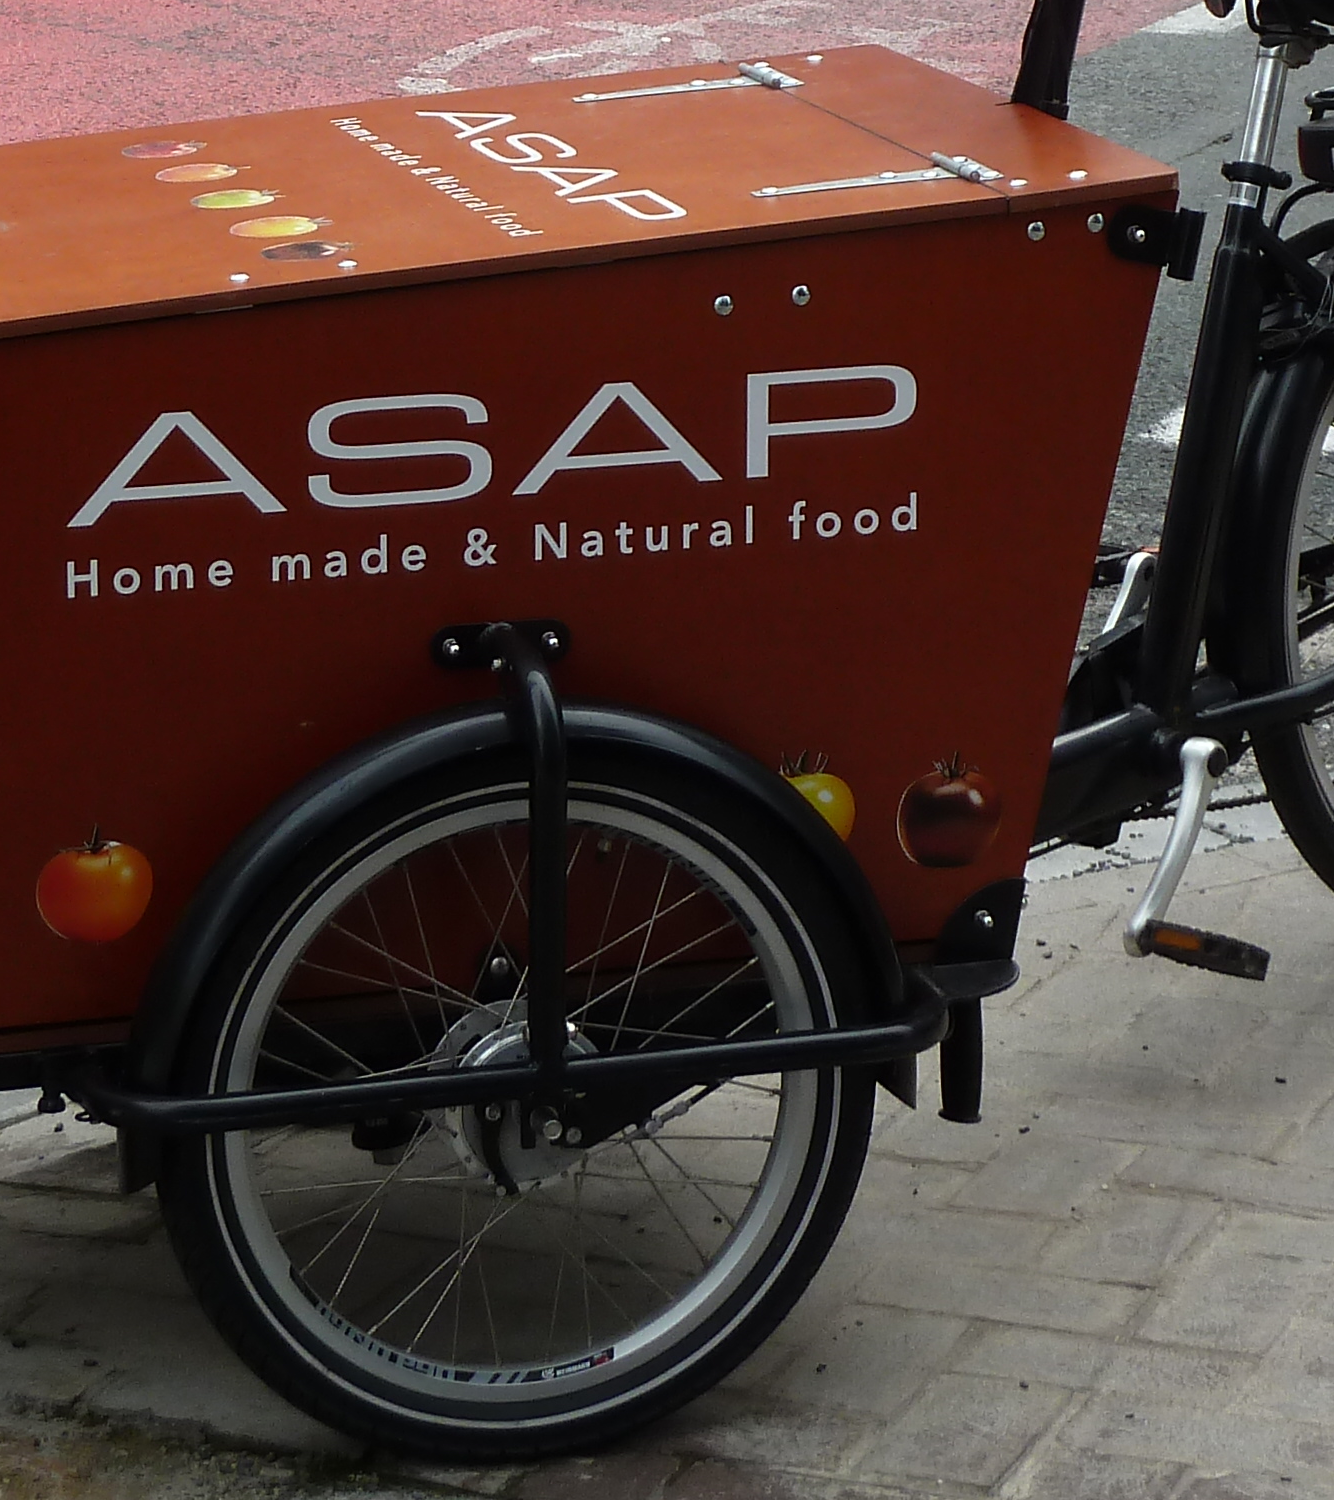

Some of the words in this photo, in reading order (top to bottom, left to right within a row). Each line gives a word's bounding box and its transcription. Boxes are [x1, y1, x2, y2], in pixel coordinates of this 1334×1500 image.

[329, 116, 378, 143] Home
[369, 142, 422, 167] made
[410, 166, 442, 176] &
[415, 110, 688, 221] ASAP
[425, 175, 504, 212] Natural
[484, 204, 544, 238] food
[66, 364, 918, 528] ASAP
[66, 559, 235, 599] Home
[270, 534, 427, 584] made
[464, 527, 498, 567] &
[534, 505, 754, 561] Natural
[789, 492, 919, 542] food
